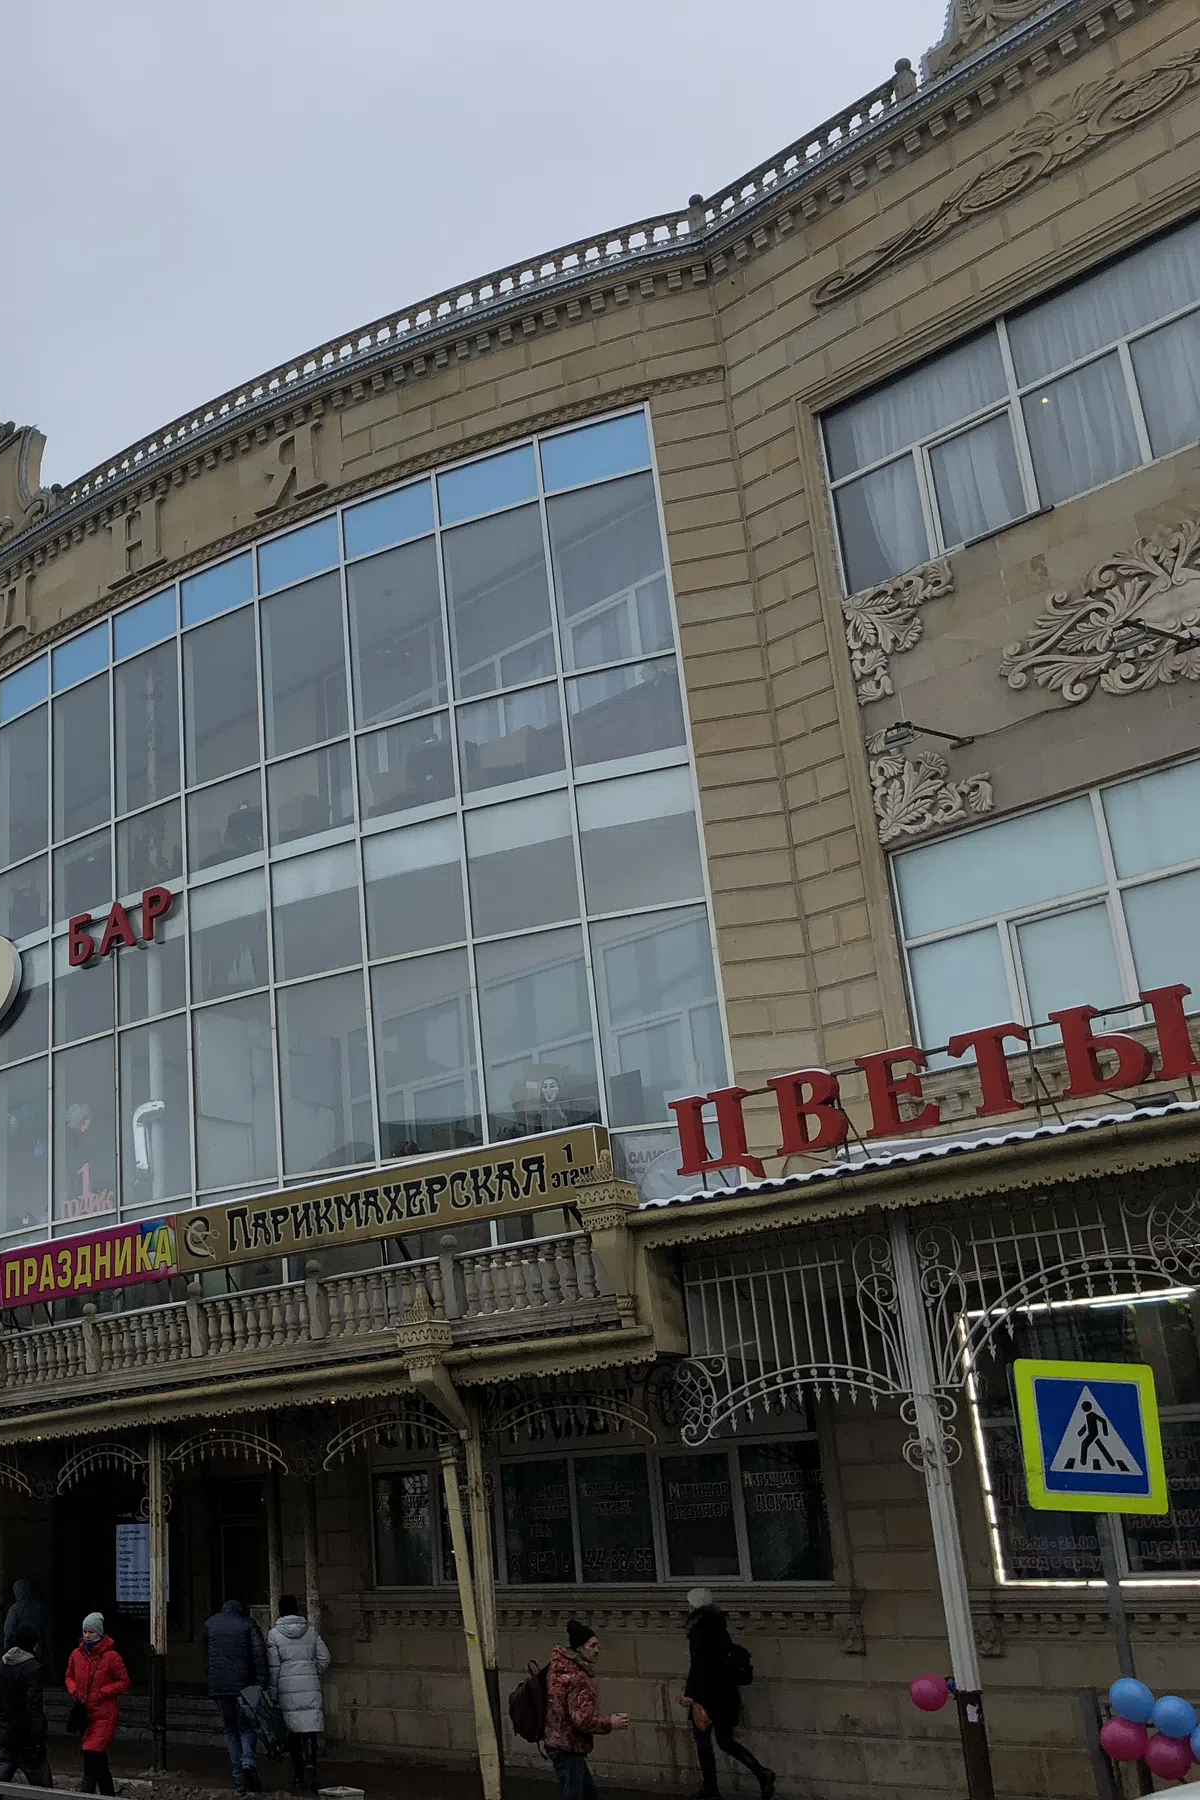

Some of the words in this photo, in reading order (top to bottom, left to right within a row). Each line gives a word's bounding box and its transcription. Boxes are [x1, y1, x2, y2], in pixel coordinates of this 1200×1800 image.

[69, 887, 171, 966] БАР
[668, 984, 1200, 1178] ЦВЕТЫ
[561, 1143, 574, 1164] 1
[5, 1229, 173, 1299] ПРАЗДНИКА
